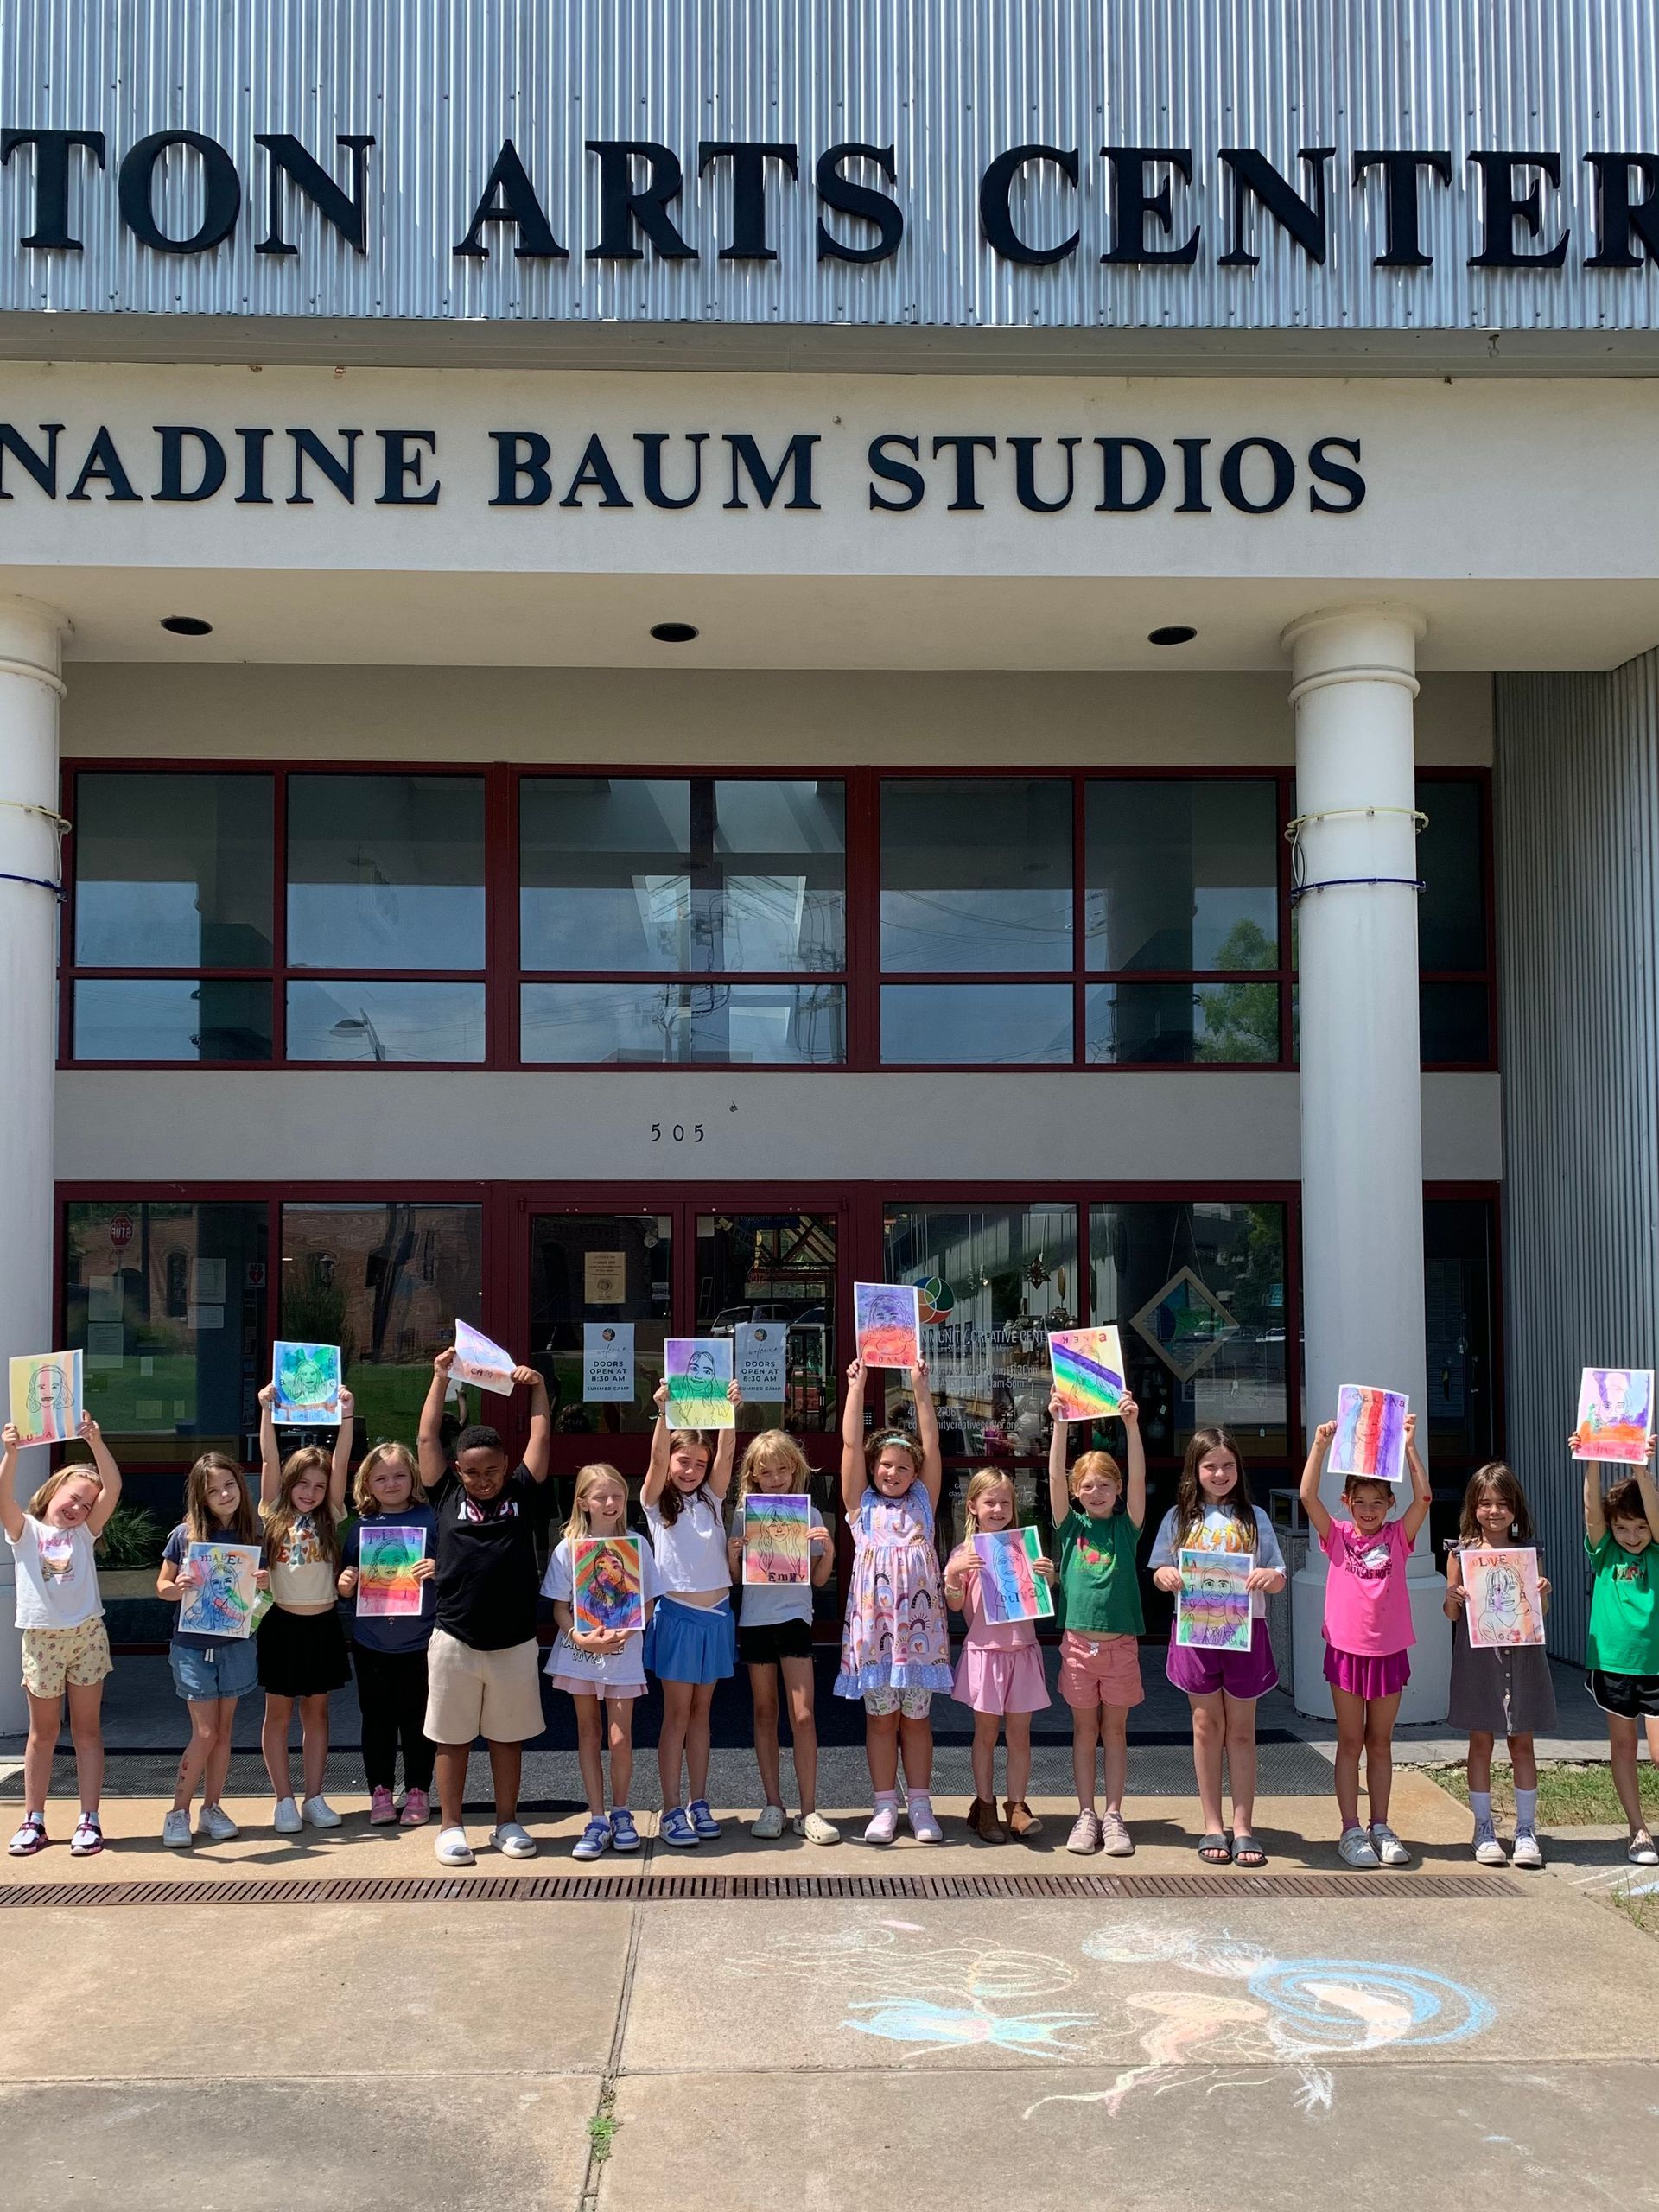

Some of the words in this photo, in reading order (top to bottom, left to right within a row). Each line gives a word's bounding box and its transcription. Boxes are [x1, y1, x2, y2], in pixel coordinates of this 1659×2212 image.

[1, 128, 377, 256] TON
[452, 138, 904, 264] ARTS
[978, 143, 1659, 268] CENTER
[0, 423, 442, 505] NADINE
[488, 431, 822, 511] BAUM
[868, 434, 1367, 514] STUDIOS
[651, 1123, 704, 1142] 505
[1020, 1329, 1050, 1344] CENTE
